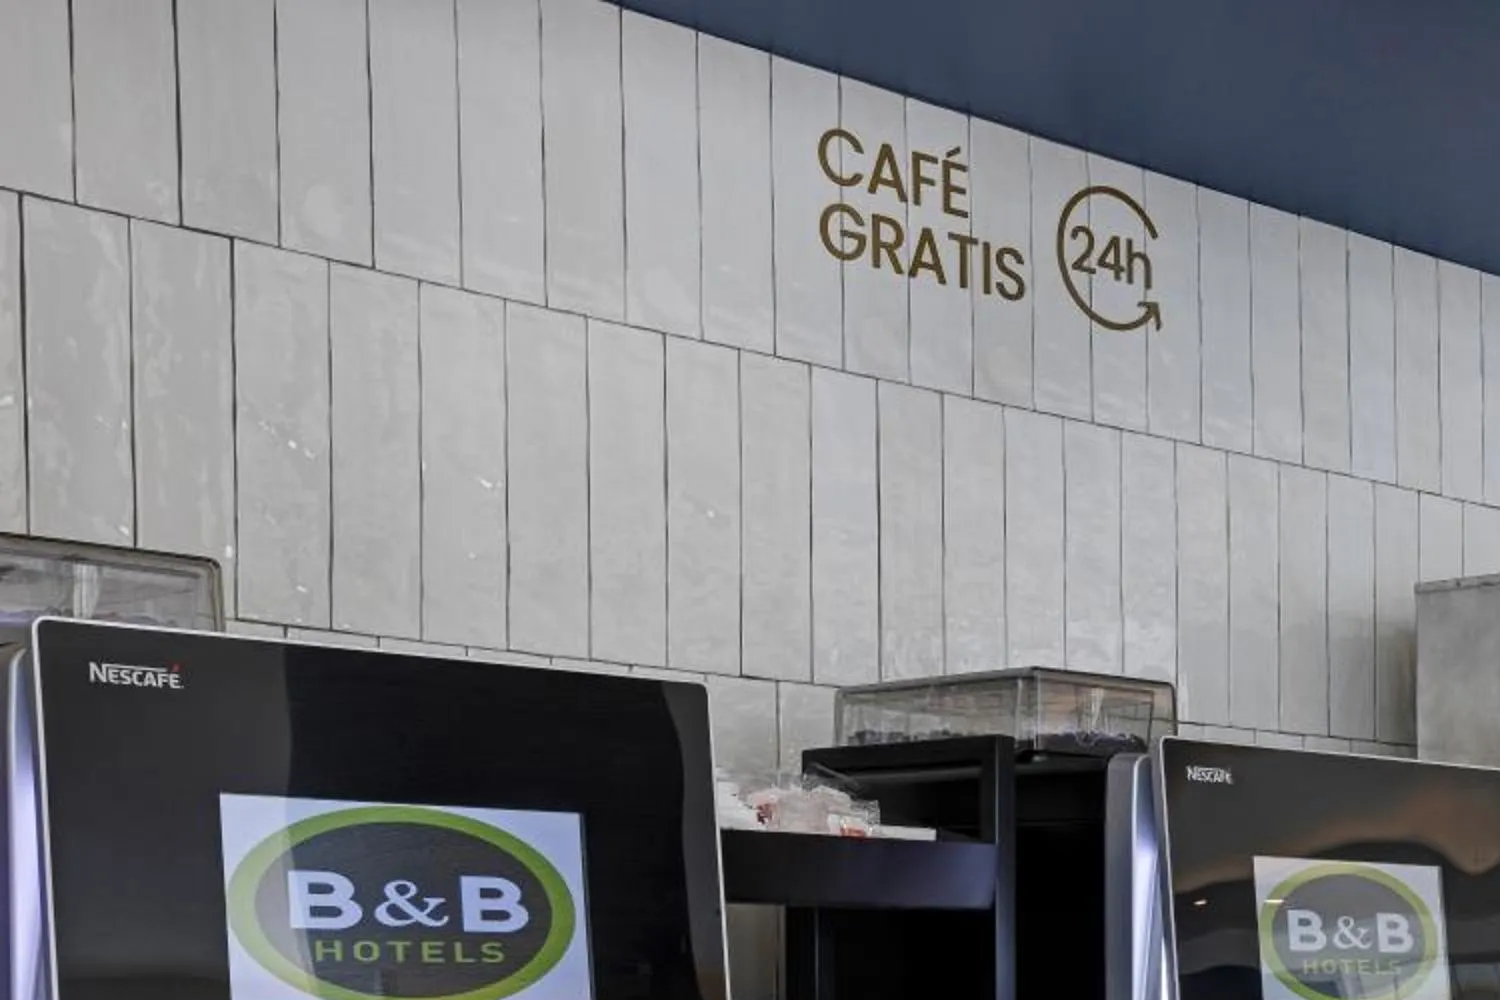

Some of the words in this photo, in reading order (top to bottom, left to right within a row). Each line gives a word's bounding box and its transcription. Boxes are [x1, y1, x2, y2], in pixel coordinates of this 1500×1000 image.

[817, 128, 968, 219] CAFÉ
[819, 203, 1025, 301] GRATIS
[1070, 225, 1152, 290] 24h
[315, 940, 505, 963] HOTELS
[1303, 958, 1402, 976] HOTELS
